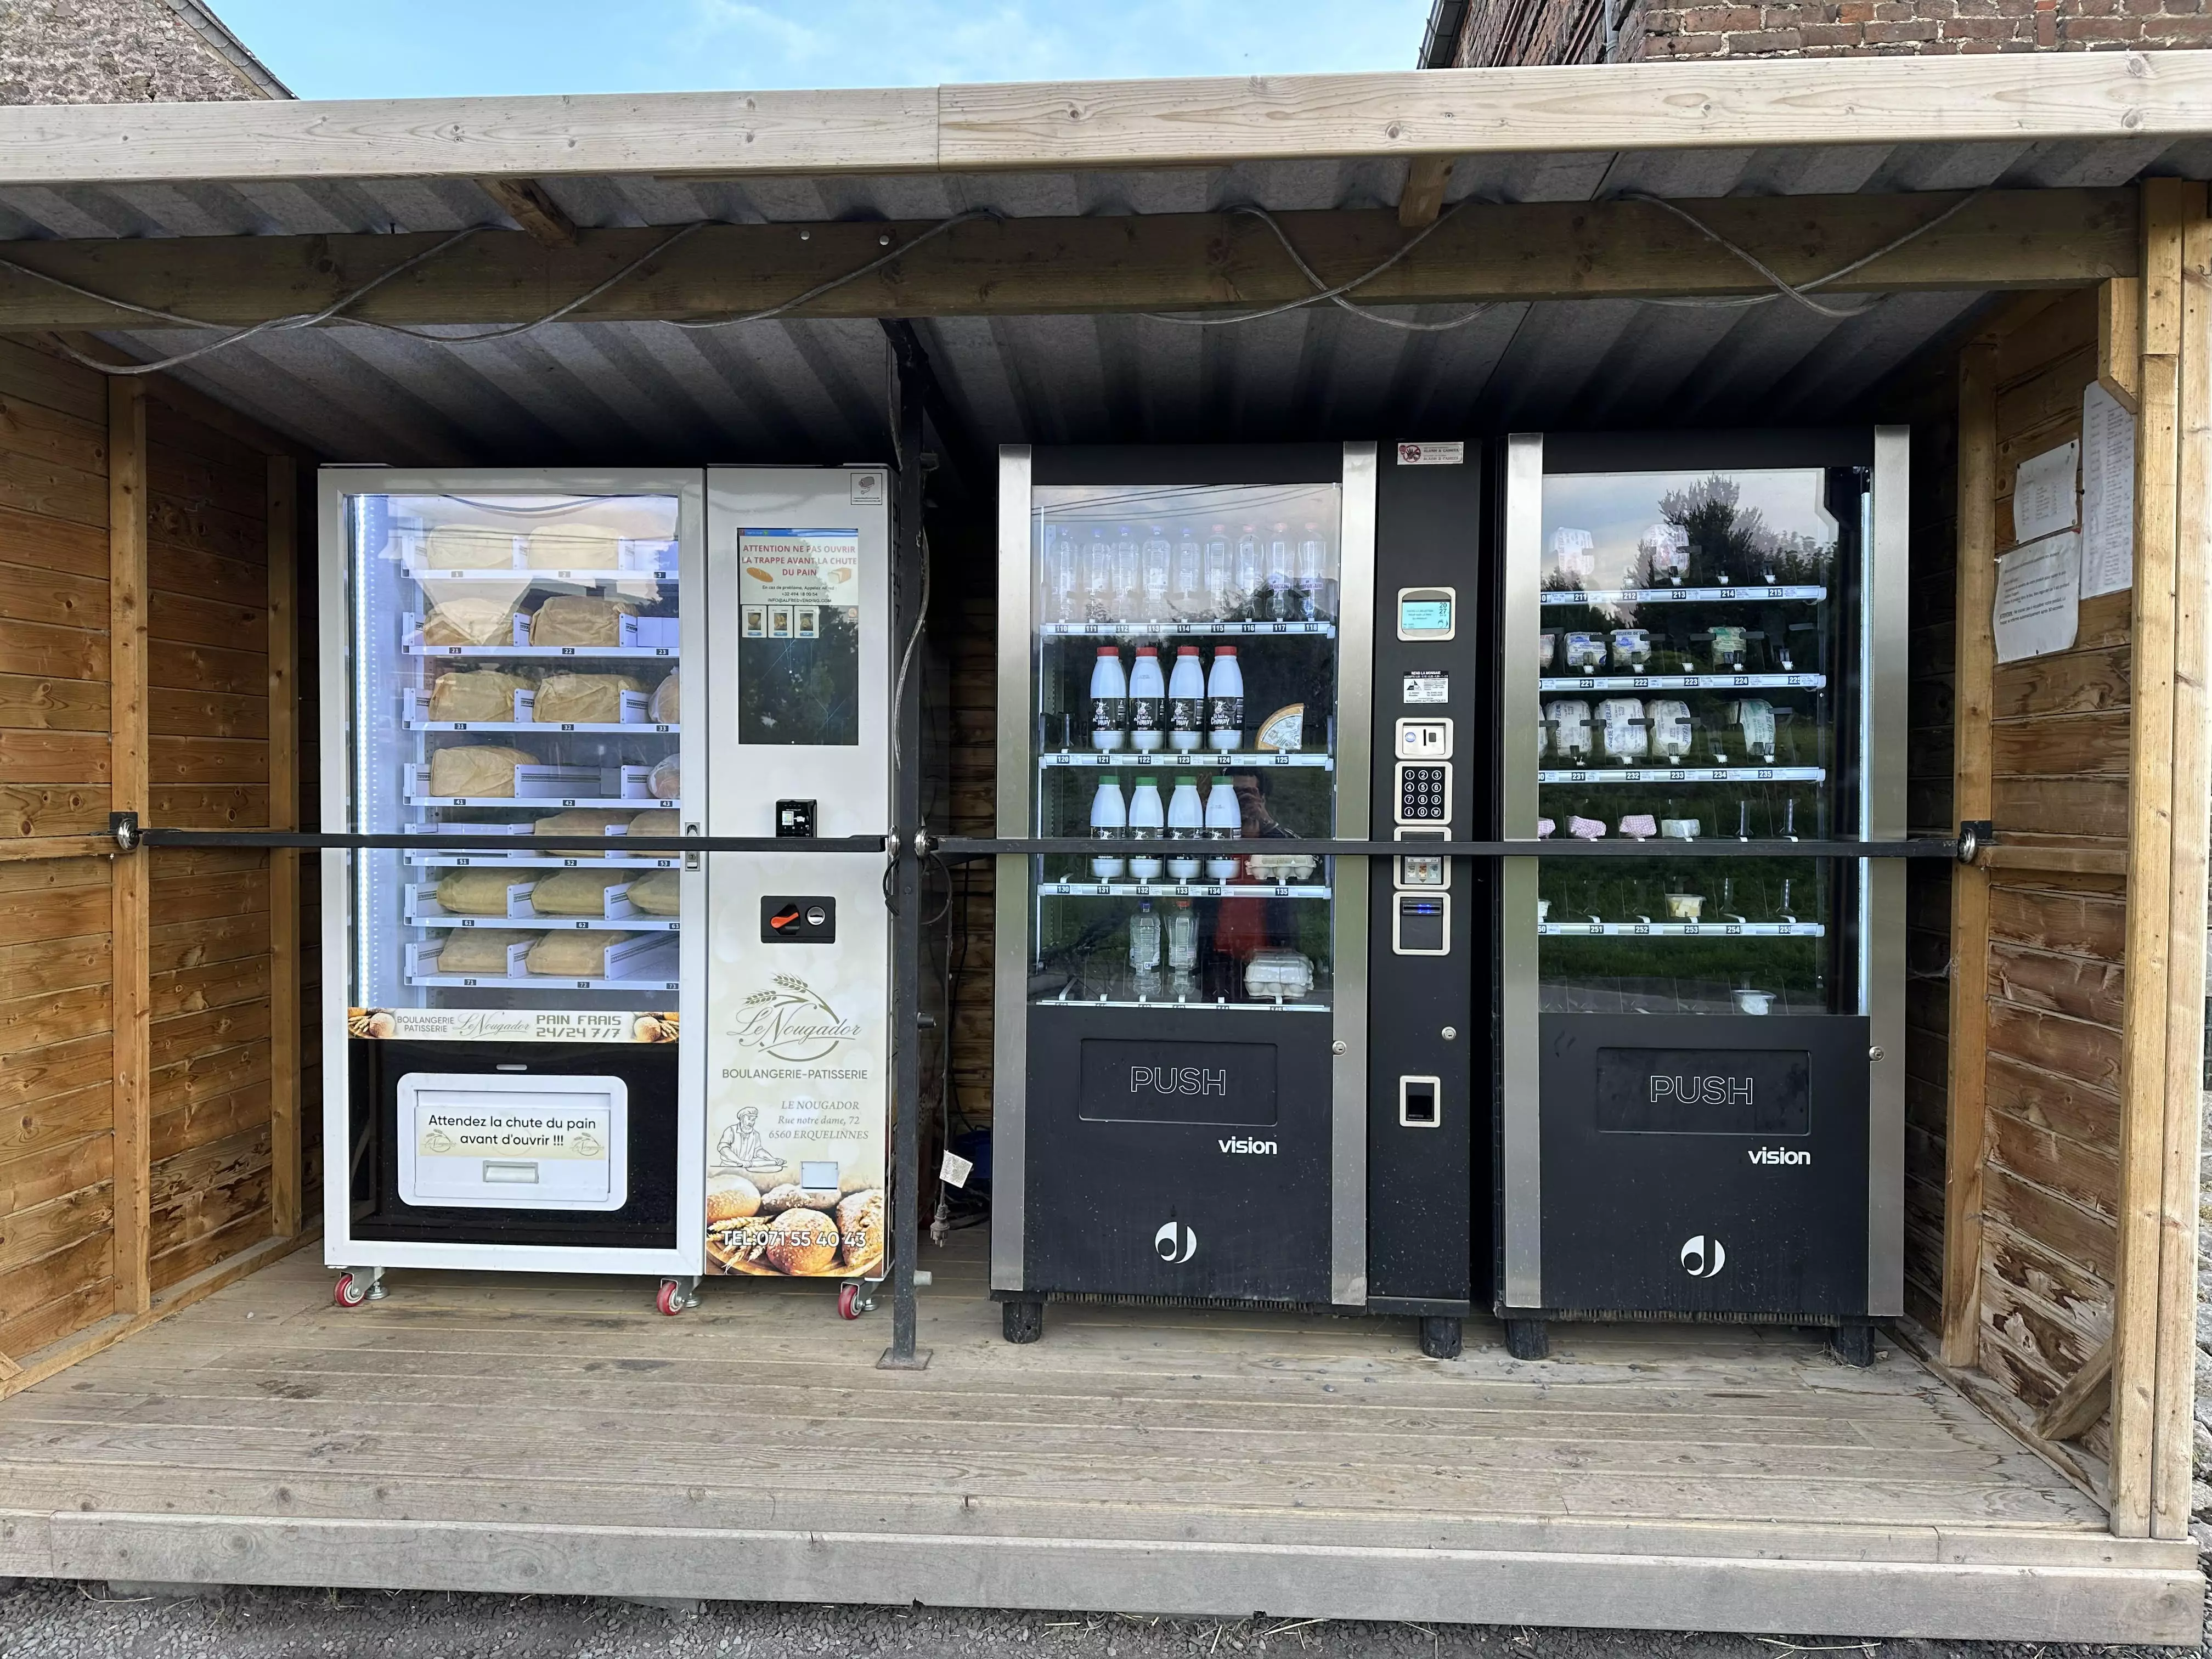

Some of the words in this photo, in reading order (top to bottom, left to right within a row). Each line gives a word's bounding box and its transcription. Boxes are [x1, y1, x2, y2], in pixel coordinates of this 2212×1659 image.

[397, 1017, 454, 1025] BOULANGERIE
[468, 1012, 531, 1039] Nougador
[536, 1015, 570, 1025] PAIN
[578, 1015, 622, 1025] FRAIS
[727, 1007, 773, 1036] Le
[742, 1003, 862, 1047] Nougador
[404, 1024, 448, 1032] PATISSERIE
[536, 1027, 585, 1037] 24/24
[591, 1028, 621, 1038] 7/7
[723, 1069, 868, 1079] BOULANGERIE-PATISSERIE
[1131, 1066, 1226, 1096] PUSH
[1650, 1075, 1753, 1105] PUSH
[781, 1101, 794, 1109] LE
[797, 1101, 859, 1109] NOUGADOR
[429, 1115, 486, 1127] Attendez
[490, 1116, 501, 1127] la
[506, 1116, 543, 1128] chute
[547, 1118, 563, 1128] du
[567, 1118, 596, 1131] pain
[821, 1116, 846, 1126] dame,
[460, 1135, 498, 1144] avant
[502, 1135, 550, 1146] d'ouvrir
[553, 1135, 563, 1146] !!!
[769, 1131, 791, 1139] 6560
[793, 1131, 868, 1141] ERQUELINNES
[1218, 1136, 1277, 1154] vision
[1748, 1146, 1810, 1165] vision
[721, 1231, 786, 1246] TEL:071
[791, 1231, 811, 1246] 55
[816, 1231, 839, 1247] 40
[844, 1232, 866, 1247] 43
